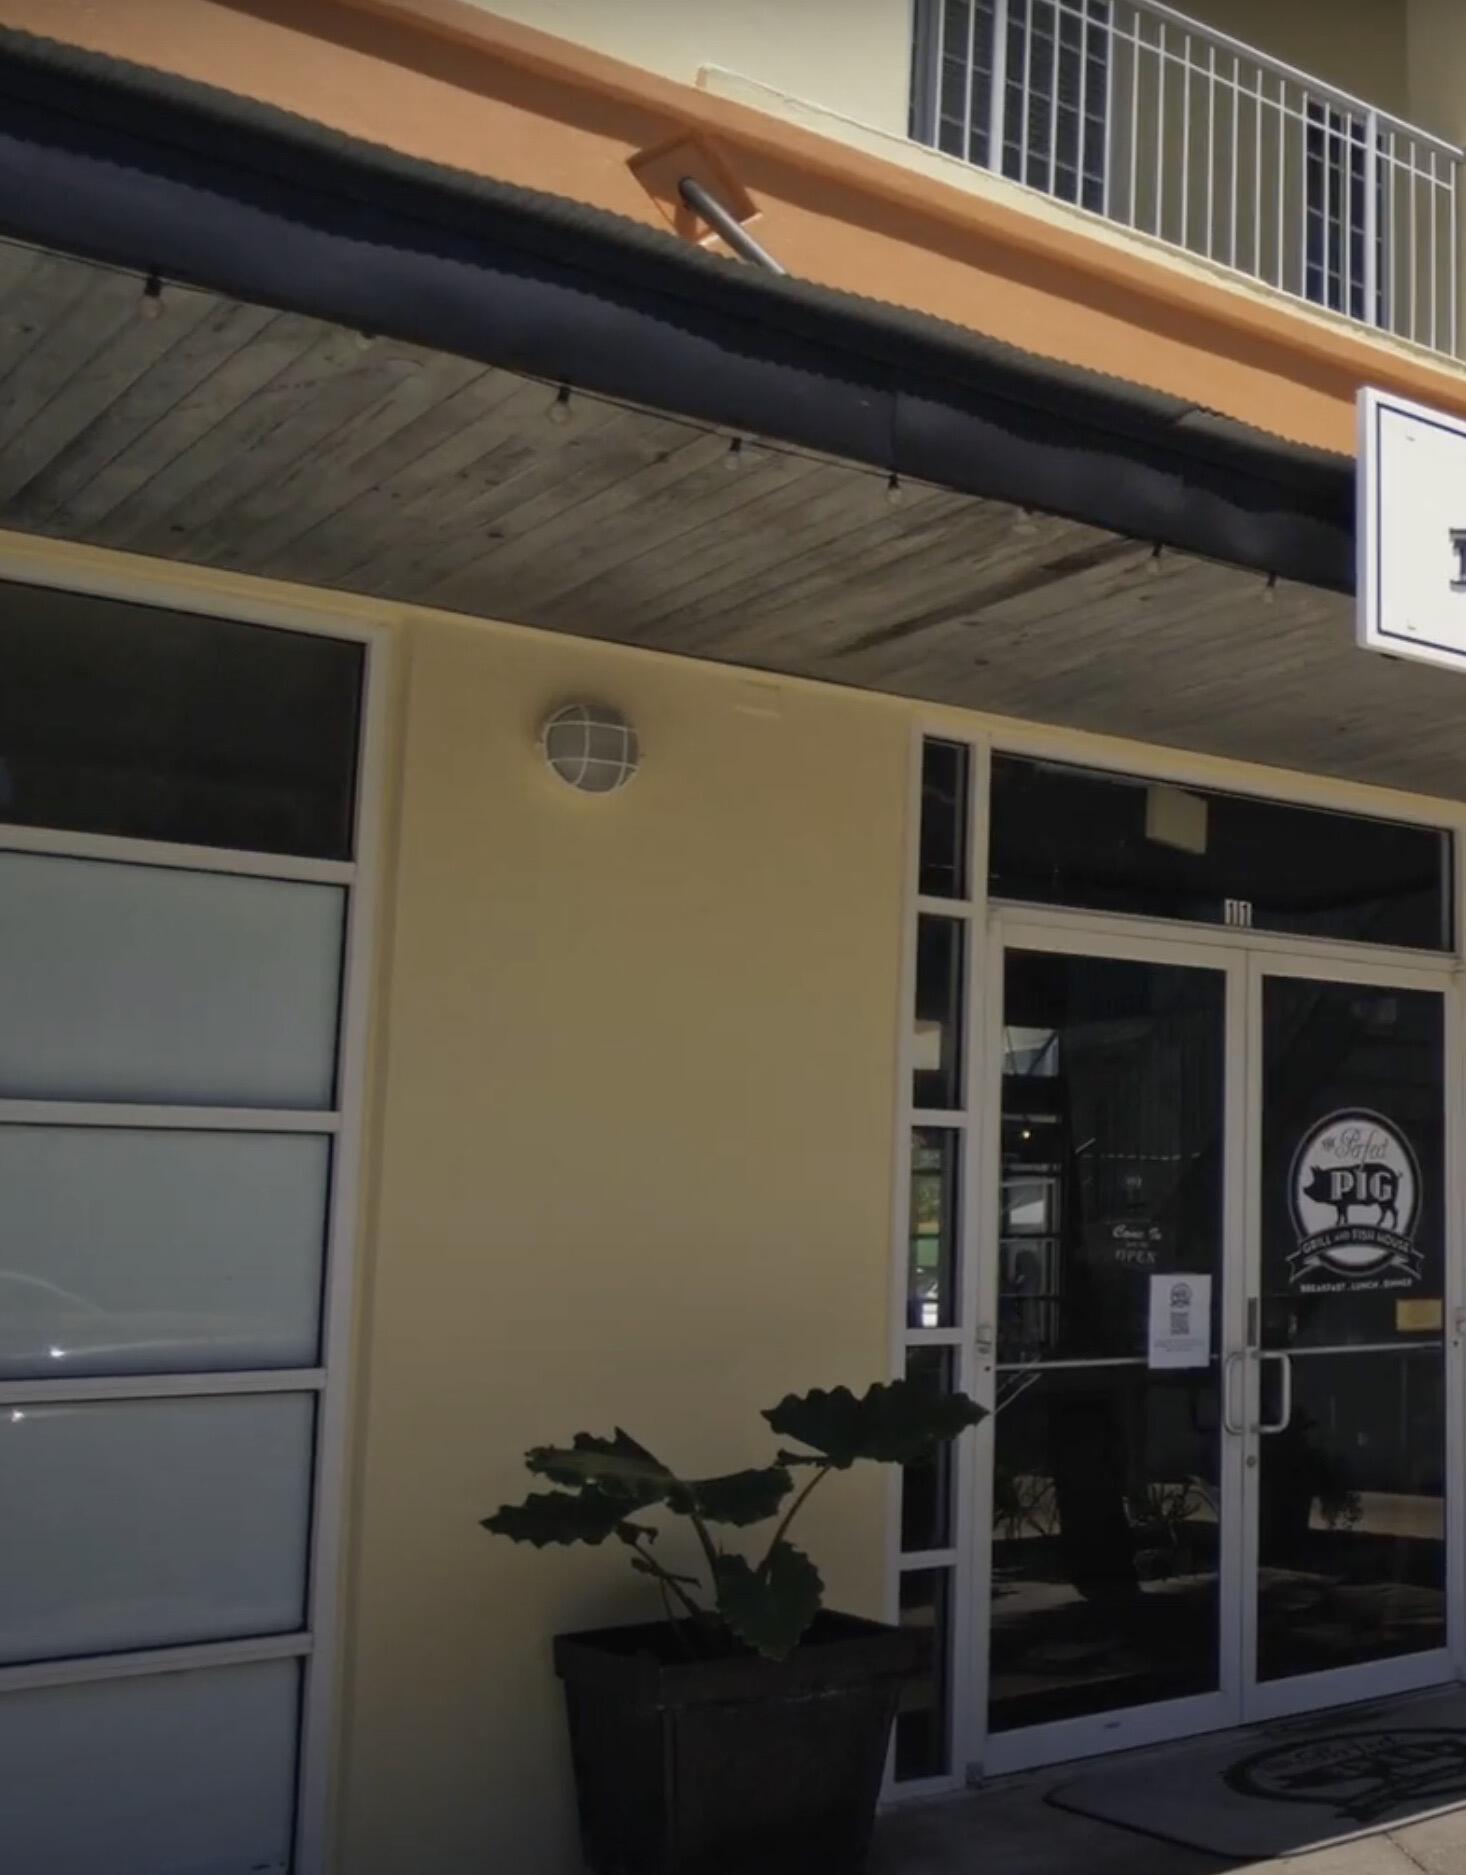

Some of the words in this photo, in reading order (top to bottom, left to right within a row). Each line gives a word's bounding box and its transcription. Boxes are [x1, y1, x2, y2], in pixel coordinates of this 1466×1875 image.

[1330, 1171, 1393, 1201] PIG
[1302, 1234, 1332, 1254] GRILL
[1352, 1228, 1375, 1242] FISH
[1377, 1231, 1411, 1252] HOUSE
